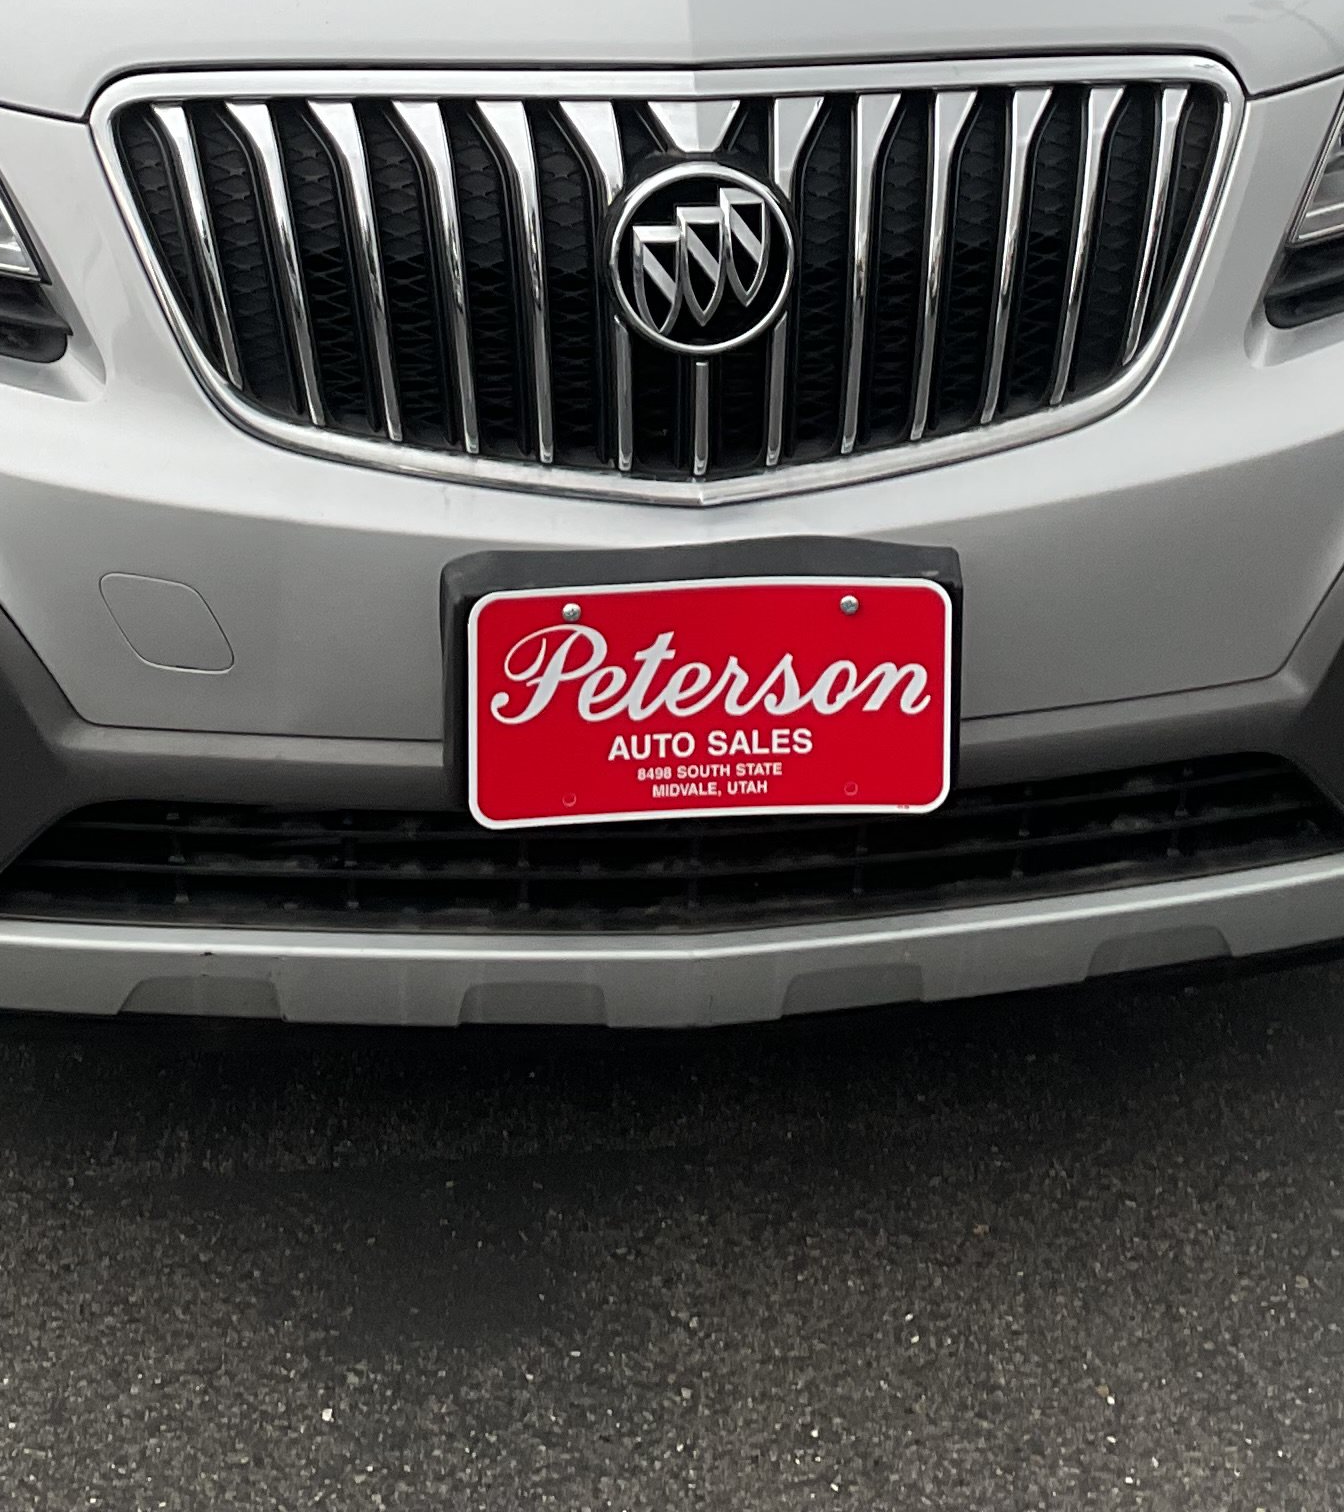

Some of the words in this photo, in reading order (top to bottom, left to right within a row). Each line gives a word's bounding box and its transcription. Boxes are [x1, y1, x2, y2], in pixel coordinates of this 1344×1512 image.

[490, 623, 932, 725] Peterson
[608, 731, 695, 761] AUTO
[707, 728, 813, 757] SALES
[637, 766, 672, 781] 8498
[677, 763, 731, 780] SOUTH
[735, 761, 783, 777] STATE
[652, 781, 722, 798] MIDVALE,
[727, 780, 768, 796] UTAH
